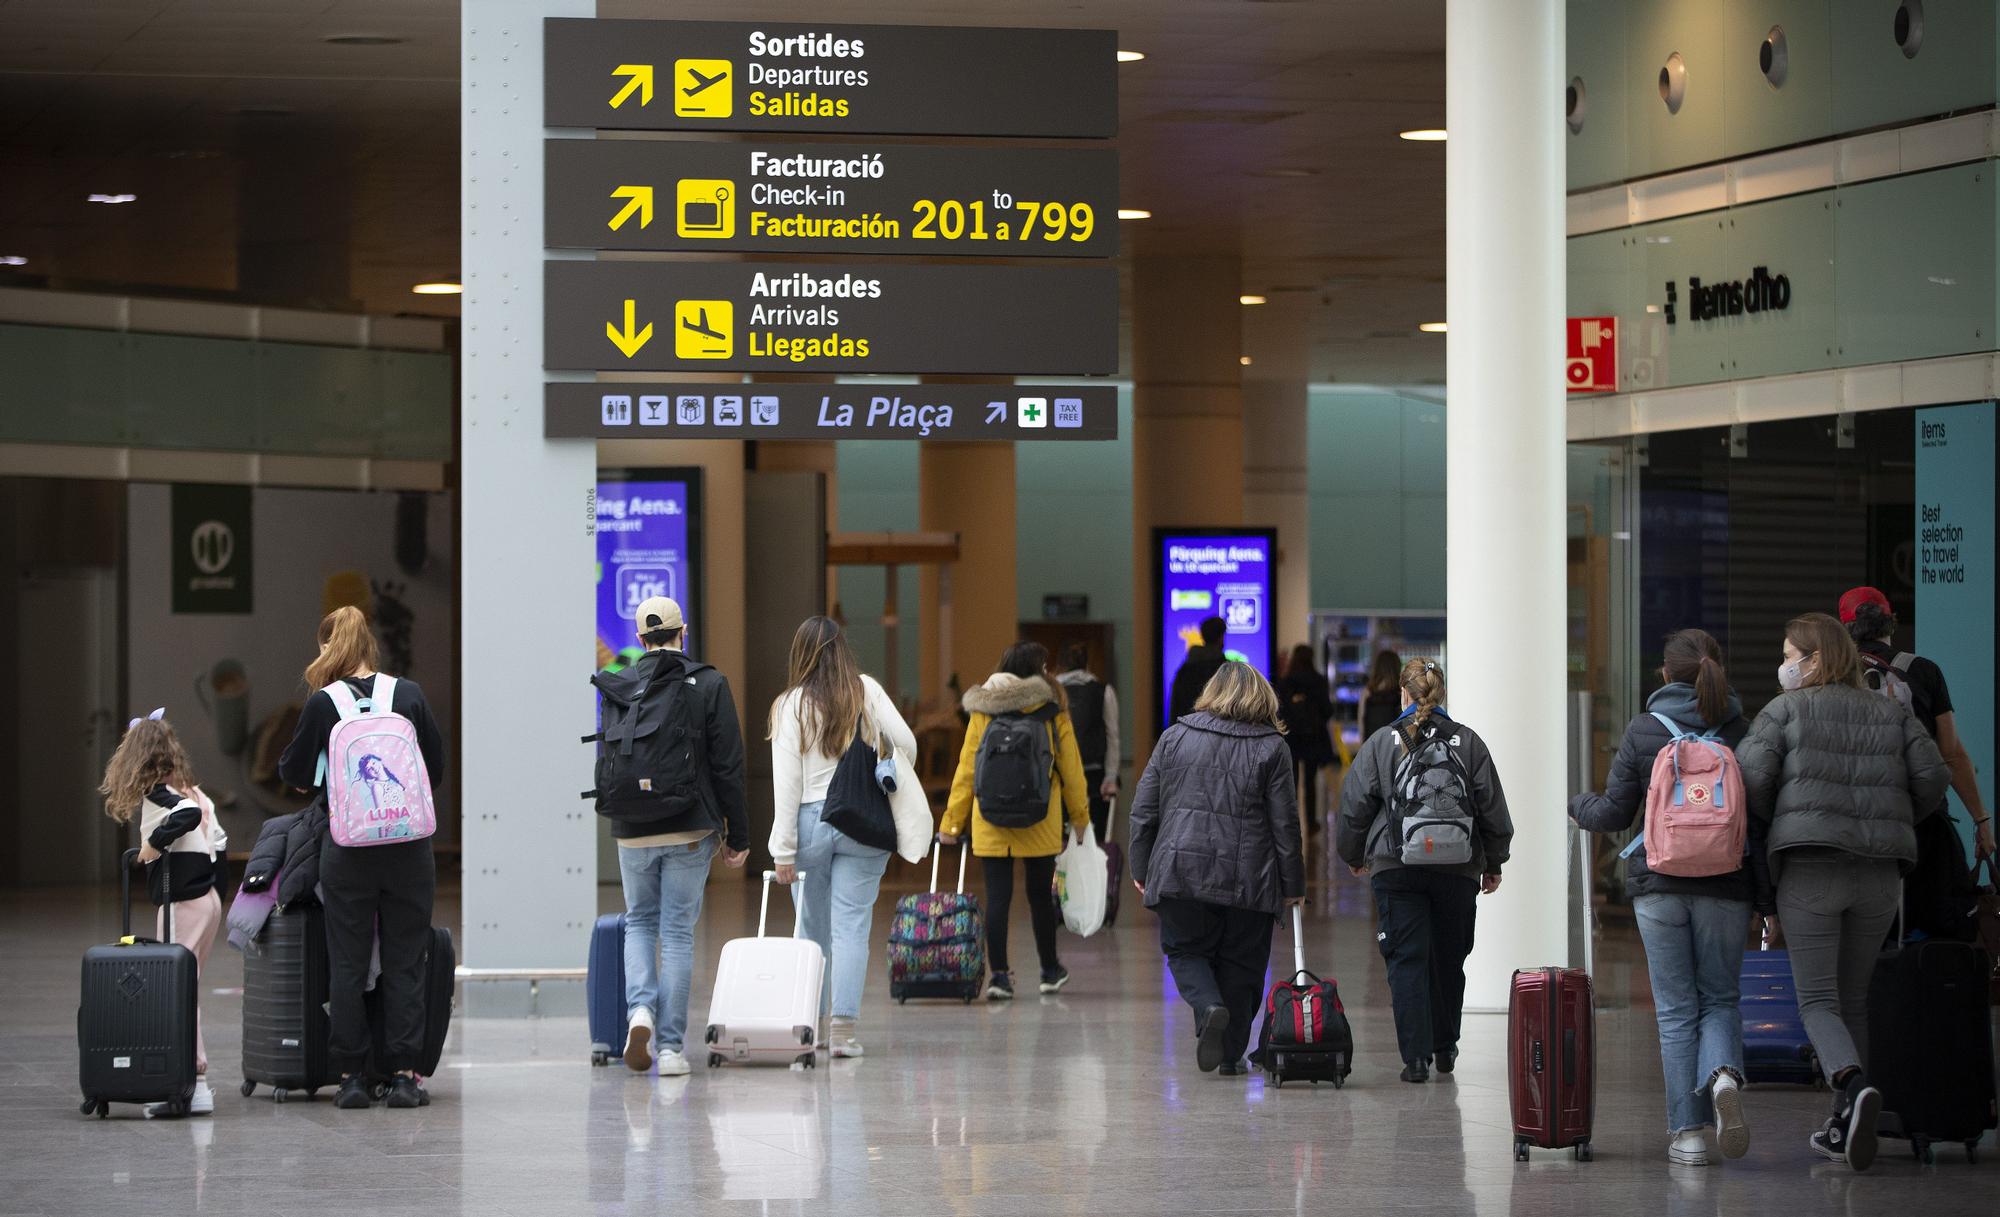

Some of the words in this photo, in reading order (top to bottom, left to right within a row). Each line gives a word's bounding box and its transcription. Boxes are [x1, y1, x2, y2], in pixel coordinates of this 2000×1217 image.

[748, 31, 865, 58] Sortides
[748, 62, 869, 89] Departures
[749, 91, 849, 117] Salidas
[750, 151, 885, 179] Facturació
[750, 182, 845, 206] Check-in
[992, 189, 1013, 210] to
[750, 211, 900, 239] Facturación
[912, 199, 989, 240] 201
[995, 222, 1010, 241] a
[1016, 201, 1094, 242] 799
[749, 272, 882, 299] Arribades
[749, 303, 840, 326] Arrivals
[749, 331, 870, 363] Llegadas
[816, 396, 854, 427] La
[866, 396, 953, 437] Plaça
[1059, 413, 1079, 421] FREE
[1060, 404, 1078, 412] TAX
[1921, 420, 1946, 439] items
[586, 488, 595, 520] 00706
[596, 496, 626, 519] ing
[1922, 503, 1941, 522] Best
[586, 524, 595, 537] SE
[1921, 523, 1963, 543] selection
[1921, 545, 1931, 563] to
[1932, 543, 1959, 563] travel
[1921, 564, 1936, 584] the
[1938, 563, 1965, 584] world
[369, 806, 410, 821] LUNA
